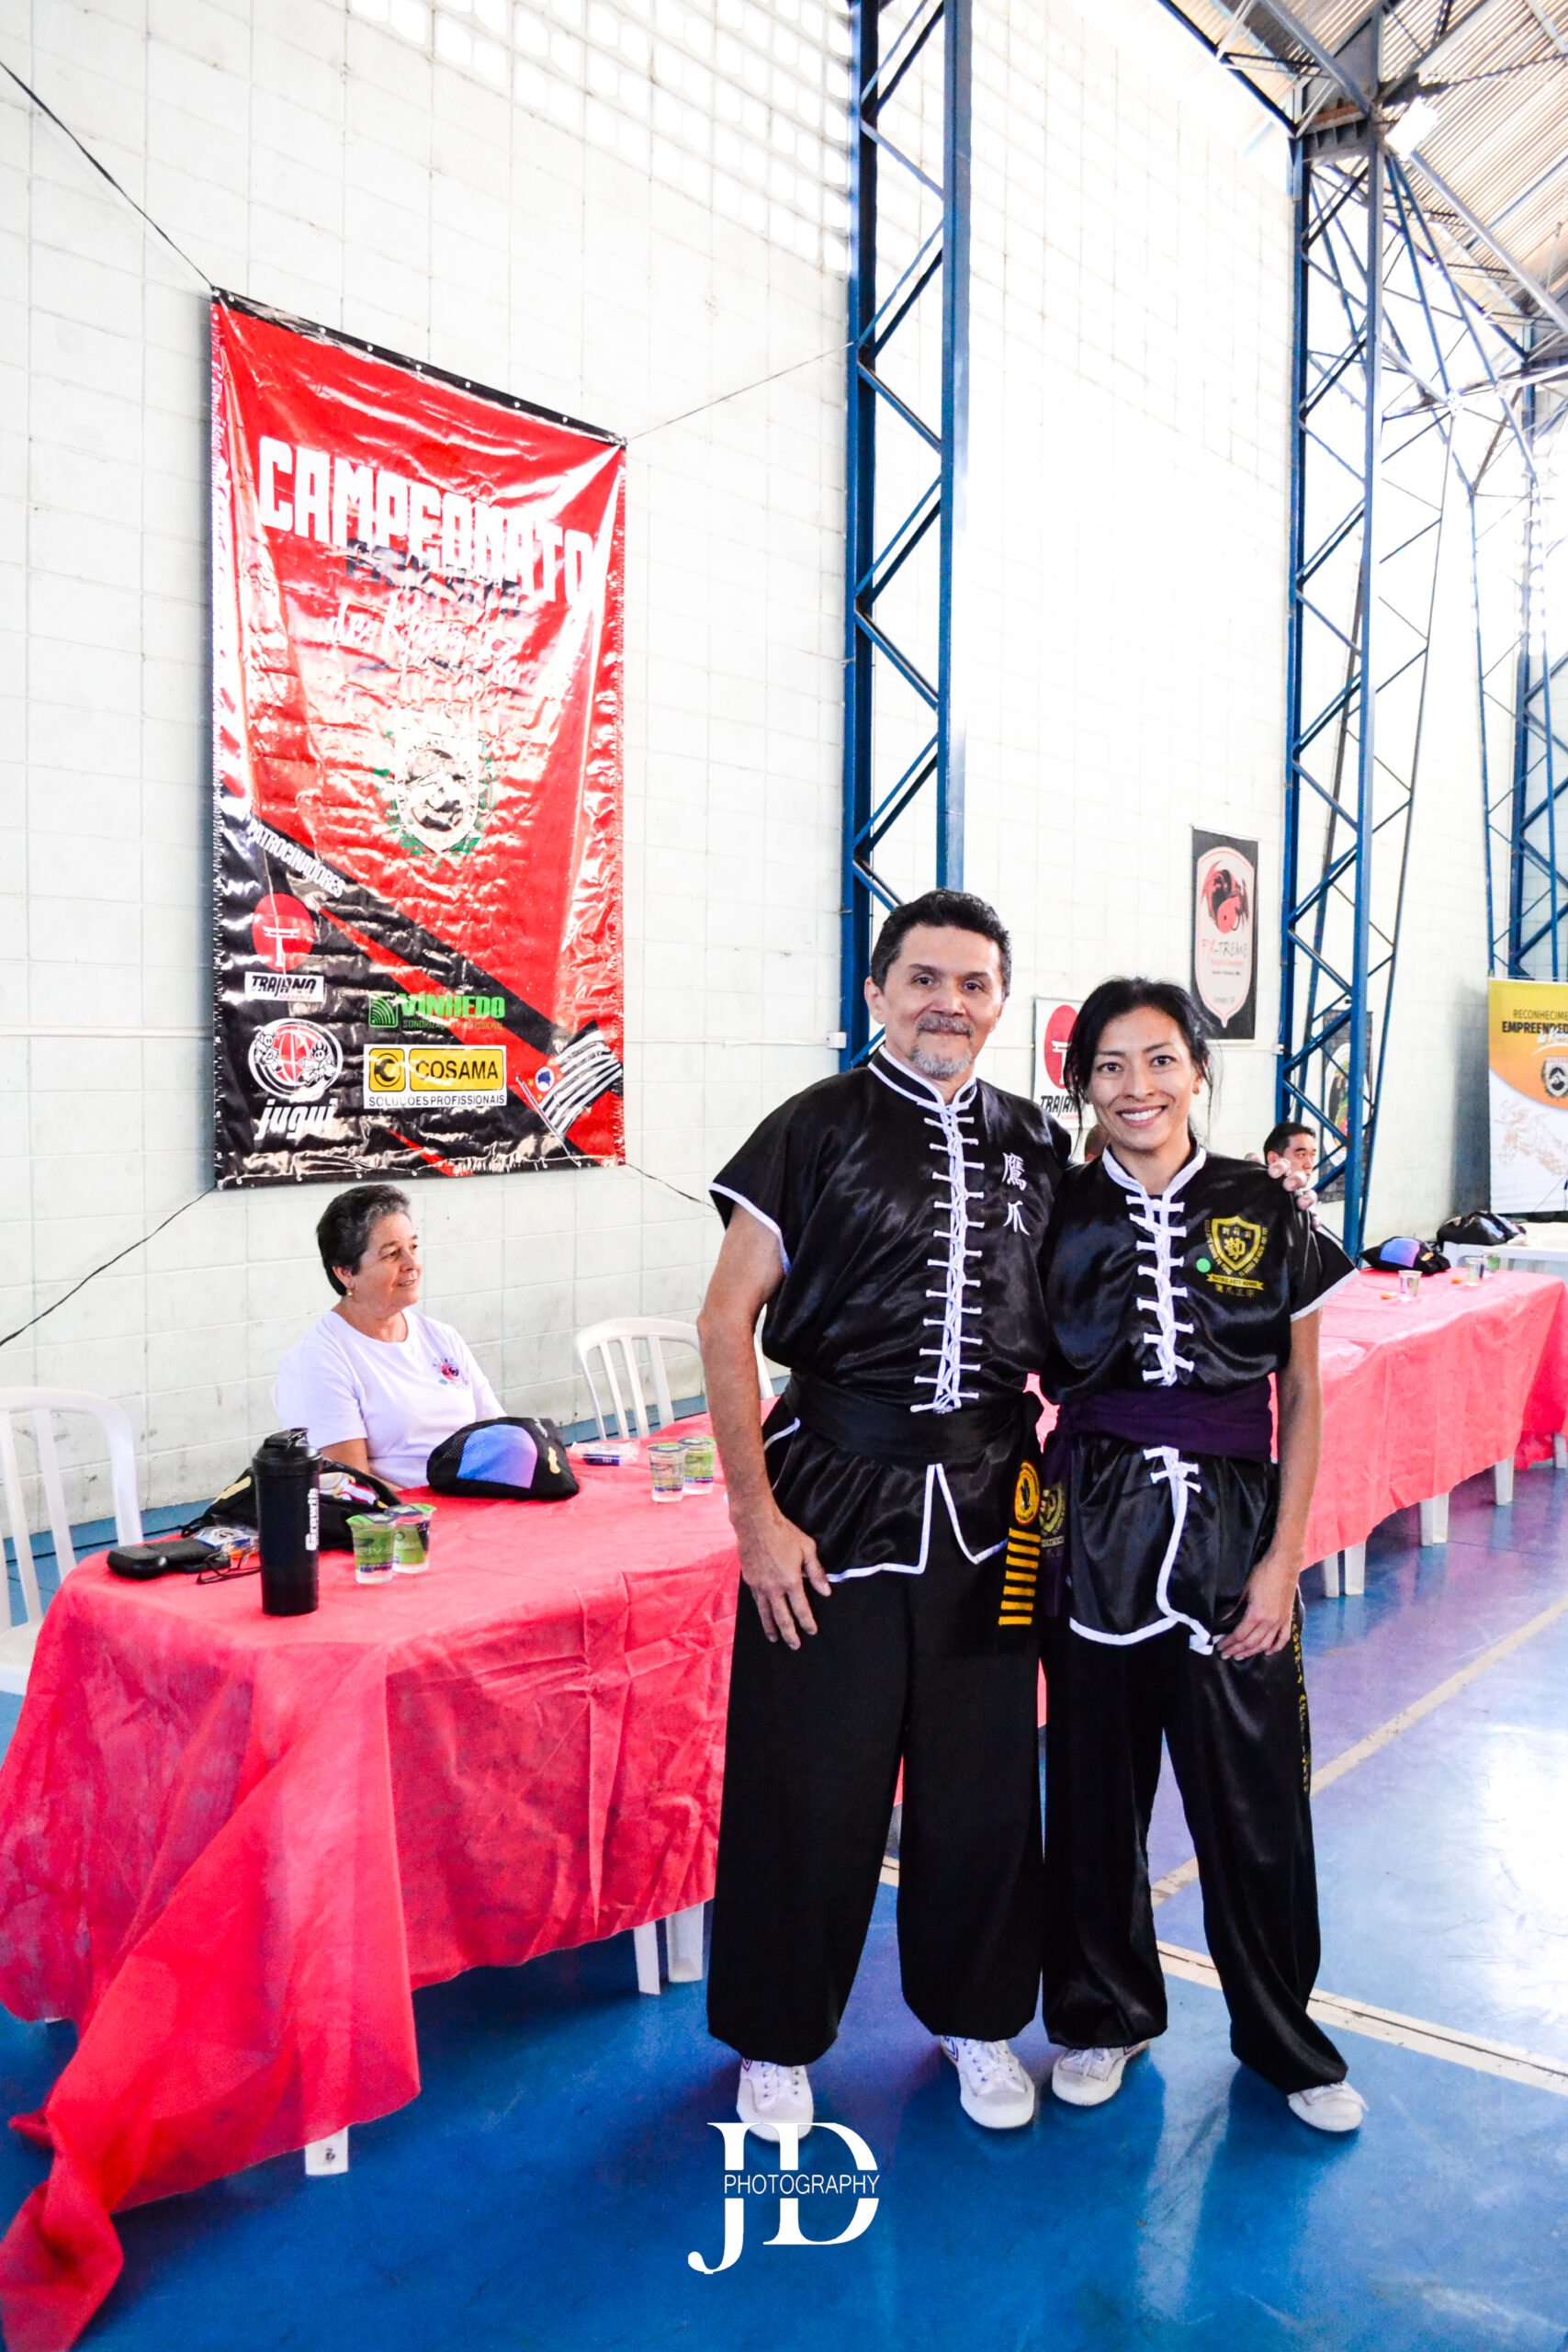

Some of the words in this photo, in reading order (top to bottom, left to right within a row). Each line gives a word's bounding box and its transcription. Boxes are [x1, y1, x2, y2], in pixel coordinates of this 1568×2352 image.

[259, 435, 594, 605] CAMPEONATO
[246, 817, 345, 898] PATROCINADORES
[398, 993, 505, 1018] VINHEDO
[403, 1019, 455, 1030] SONORIZAÇO
[415, 1060, 498, 1080] COSAMA
[430, 1094, 505, 1106] PROFISSIONAIS
[305, 1487, 319, 1551] Growth
